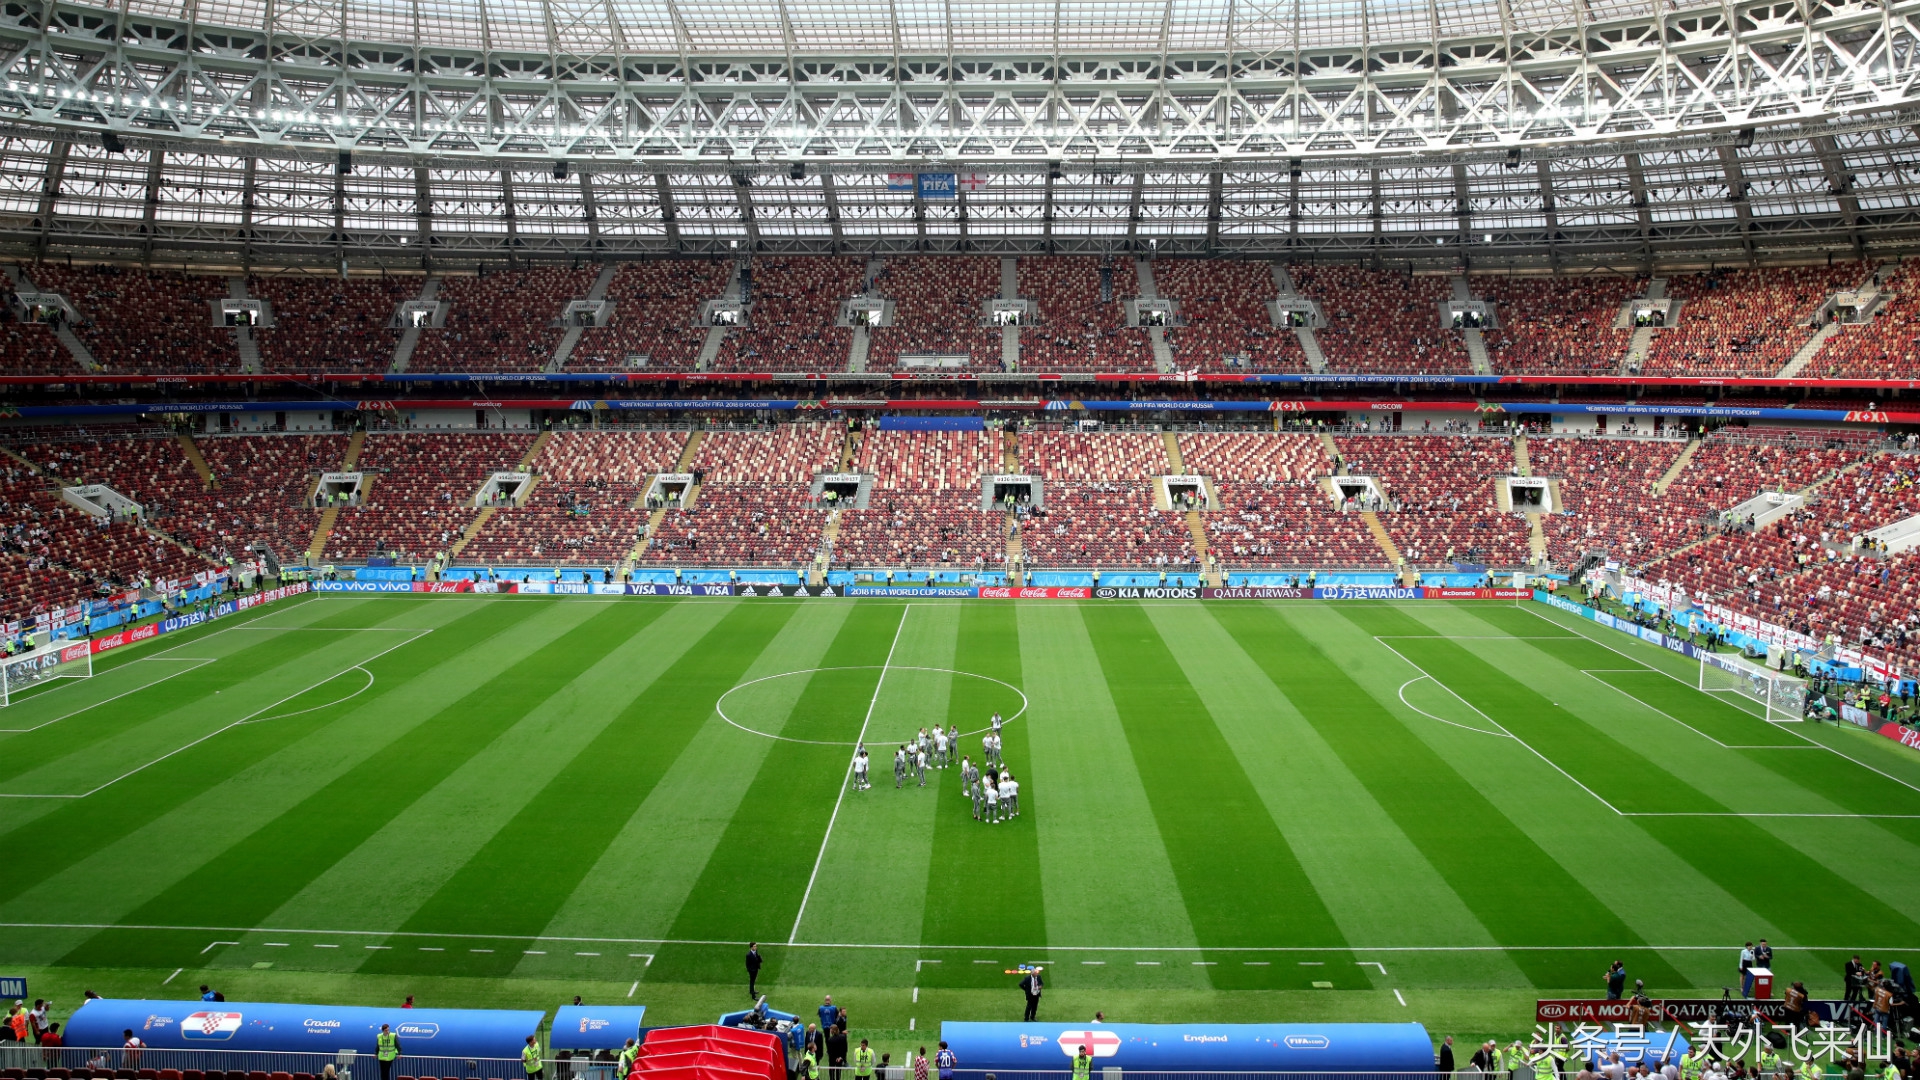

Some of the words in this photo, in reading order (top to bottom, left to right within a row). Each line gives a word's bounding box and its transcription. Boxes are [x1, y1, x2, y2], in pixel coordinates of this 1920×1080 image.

[923, 181, 949, 190] FIFA
[345, 581, 376, 591] vivo
[379, 581, 410, 591] vivo
[428, 582, 457, 593] Bud
[554, 584, 588, 594] GAZPROM
[631, 585, 656, 594] VISA
[666, 585, 692, 595] VISA
[703, 585, 729, 595] VISA
[850, 587, 869, 595] 2018
[889, 588, 918, 596] WORLD
[920, 588, 936, 596] CUP
[938, 588, 968, 596] RUSSIA
[1119, 588, 1140, 598] KIA
[1144, 588, 1196, 598] MOTORS
[1214, 588, 1252, 598] QATAR
[1254, 588, 1302, 598] AIRWAYS
[1341, 588, 1367, 598] 万达
[1369, 588, 1415, 598] WANDA
[1546, 594, 1583, 616] Hisense
[200, 604, 233, 622] WADA
[179, 612, 200, 629] 万达
[1666, 637, 1684, 653] VISA
[1543, 1007, 1563, 1015] KIA
[1569, 1005, 1594, 1016] KIA
[1598, 1005, 1661, 1016] MOTS
[1666, 1004, 1717, 1017] QATAR
[303, 1018, 341, 1028] Croatia
[400, 1026, 434, 1034] FIFA.com
[1183, 1034, 1228, 1043] England
[940, 1054, 951, 1068] 20
